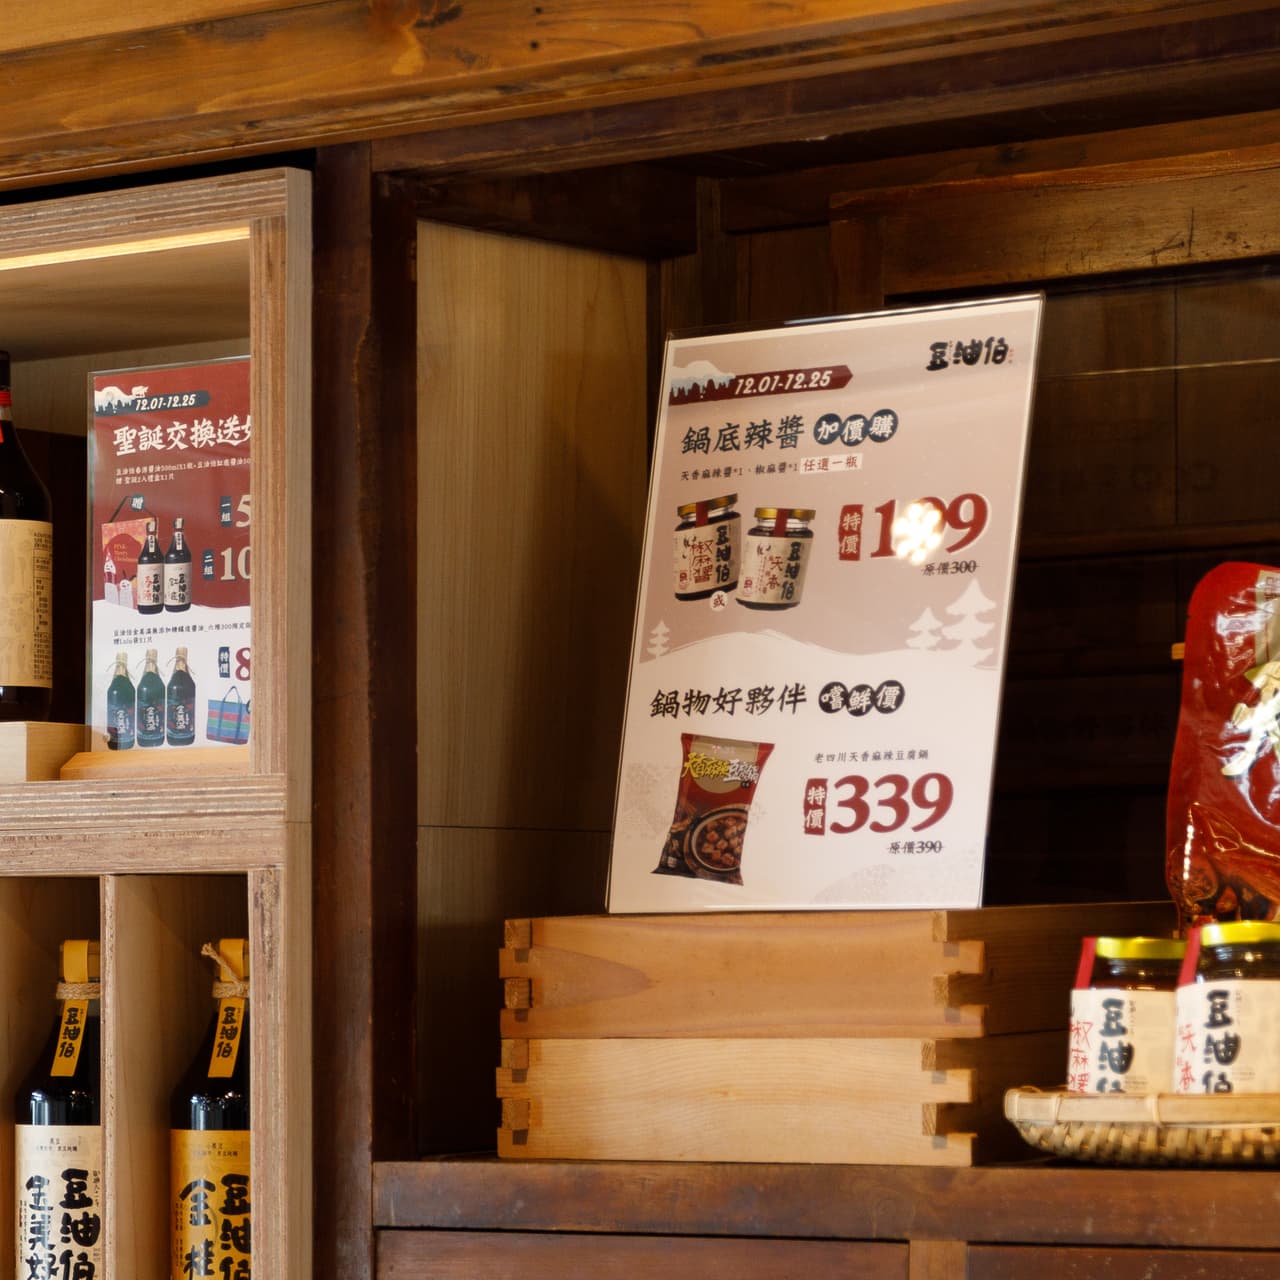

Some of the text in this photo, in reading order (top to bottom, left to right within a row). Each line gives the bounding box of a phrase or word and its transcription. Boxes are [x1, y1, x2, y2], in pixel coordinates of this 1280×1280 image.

[926, 336, 1009, 371] 豆油伯
[135, 393, 197, 412] 12.01-12.25
[734, 370, 832, 395] 12.01-12.25
[680, 414, 896, 455] 鍋底辣醬 加價購
[841, 512, 862, 555] 特價
[650, 680, 807, 720] 鍋物好夥伴
[806, 786, 826, 829] 特價
[830, 772, 954, 835] 339
[58, 1006, 81, 1059] 豆油伯
[215, 1006, 238, 1059] 豆油伯
